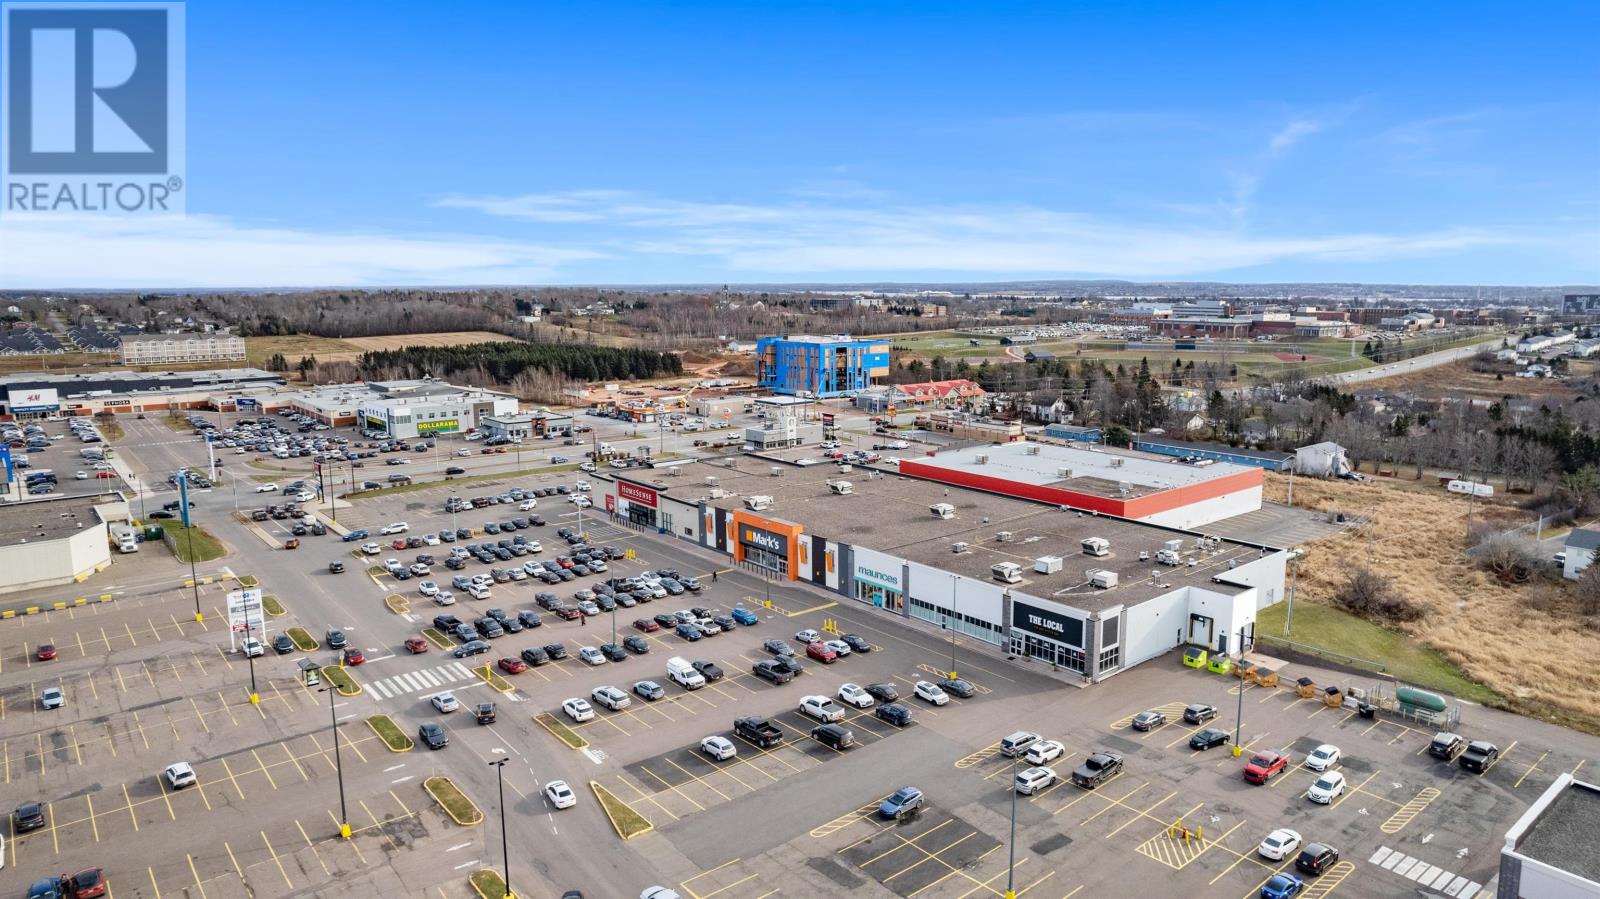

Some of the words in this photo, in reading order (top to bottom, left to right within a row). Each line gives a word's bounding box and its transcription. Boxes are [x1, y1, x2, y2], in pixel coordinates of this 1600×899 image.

[418, 420, 458, 429] DOLLARAMA
[752, 531, 780, 550] Mark's
[1028, 614, 1043, 626] THE
[1043, 618, 1065, 633] LOCAL
